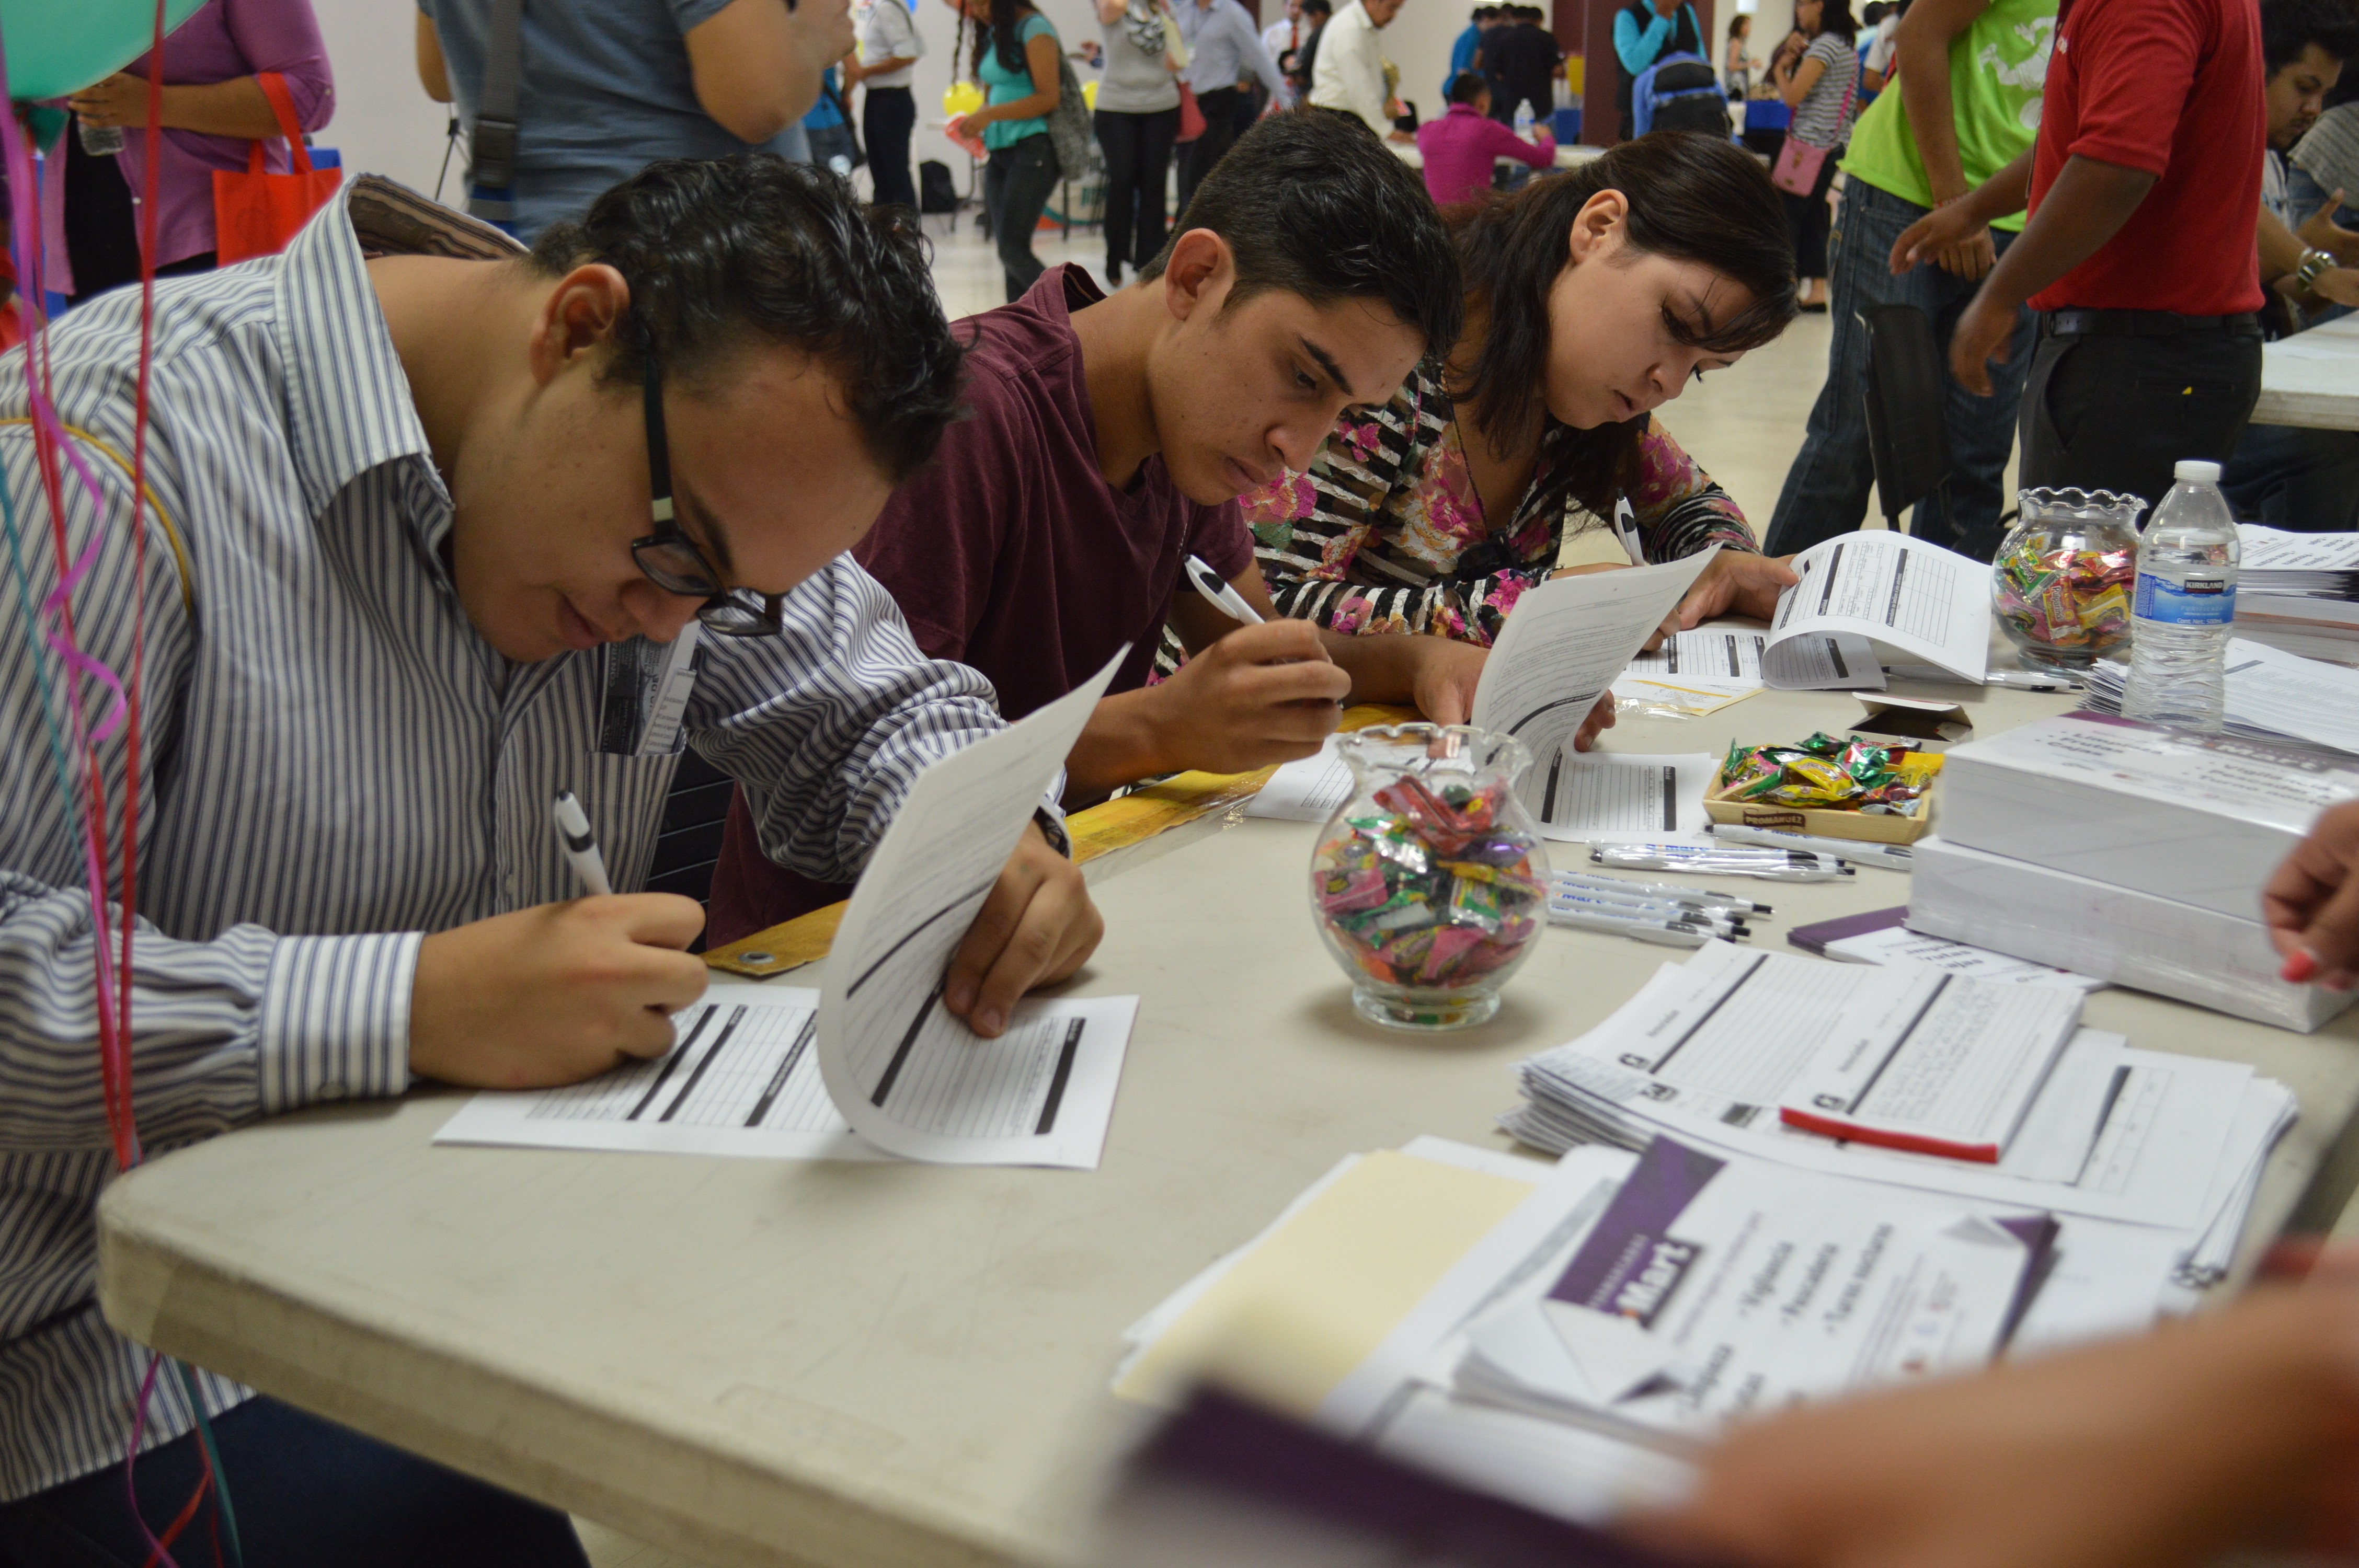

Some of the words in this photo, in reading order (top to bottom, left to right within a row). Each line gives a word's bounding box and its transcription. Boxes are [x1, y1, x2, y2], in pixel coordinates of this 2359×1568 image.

[2047, 741, 2103, 756] Cajas
[2059, 737, 2125, 753] Frutas
[1917, 950, 1973, 962] rutas
[1936, 958, 1985, 969] ajas
[1615, 1241, 1691, 1308] Mart
